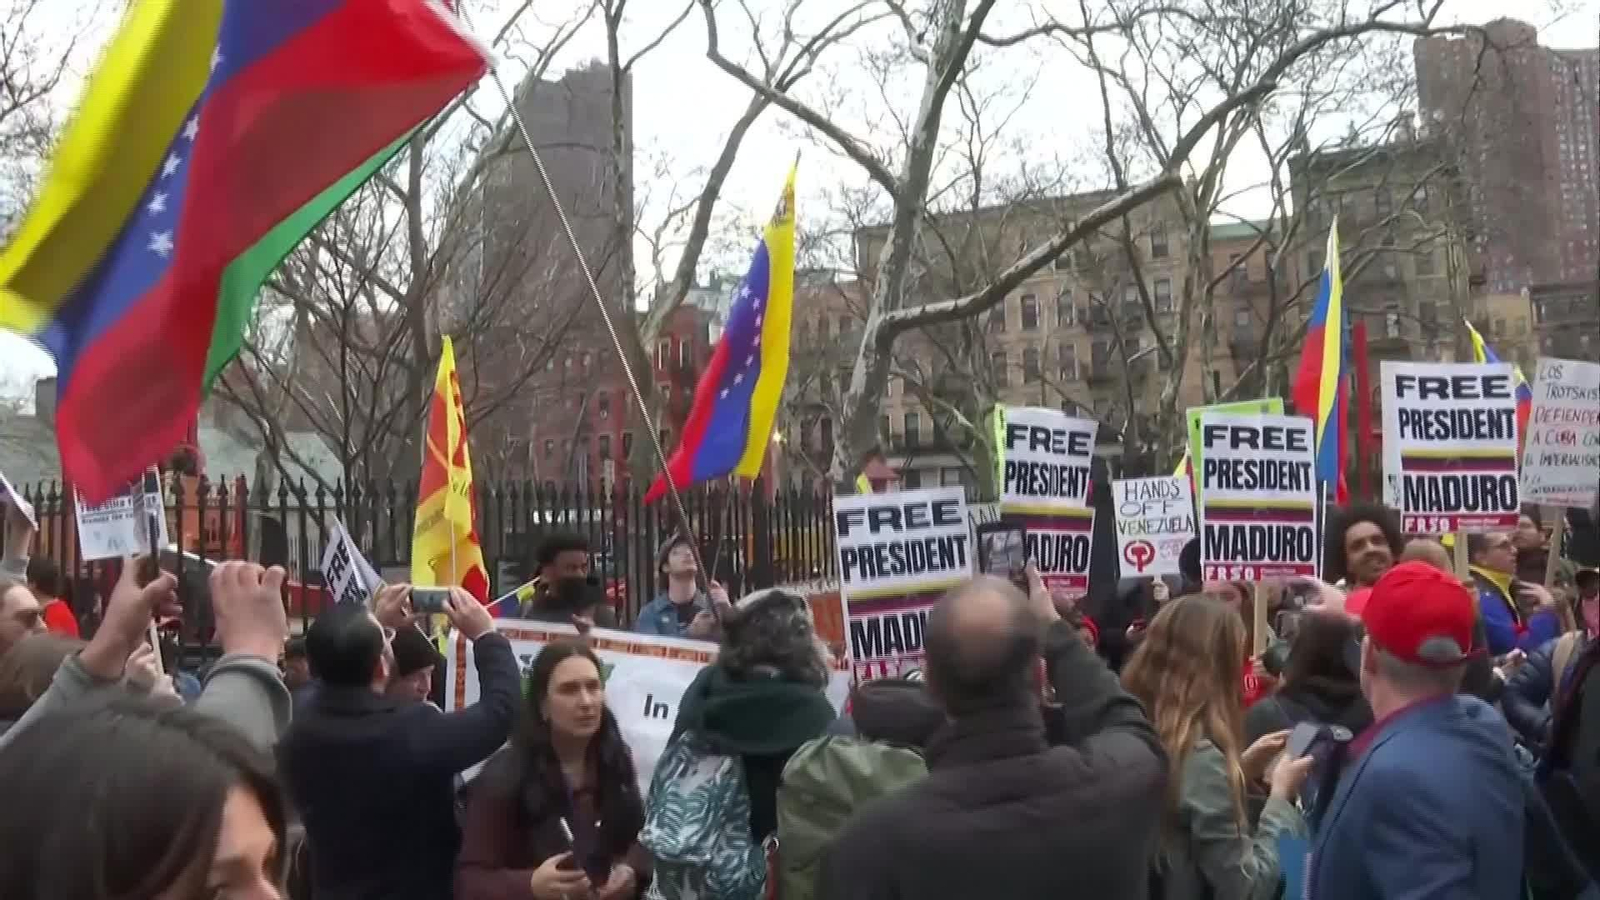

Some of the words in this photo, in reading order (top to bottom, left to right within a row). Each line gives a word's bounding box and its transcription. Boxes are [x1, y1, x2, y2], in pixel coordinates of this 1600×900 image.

[1395, 374, 1511, 400] FREE
[1006, 424, 1091, 456] FREE
[1204, 425, 1308, 451] FREE
[1398, 407, 1516, 440] PRESIDENT
[1004, 461, 1089, 499] PRESIDENT
[1125, 479, 1180, 500] HANDS
[1204, 458, 1312, 492] PRESIDENT
[1120, 501, 1173, 517] OFF
[1403, 474, 1518, 512] MADURO
[835, 500, 963, 538] FREE
[1118, 515, 1194, 535] VENEZUELA
[841, 534, 968, 583] PRESIDENT
[1027, 532, 1090, 573] ADURO
[1204, 524, 1314, 562] MADURO
[643, 693, 669, 720] In
